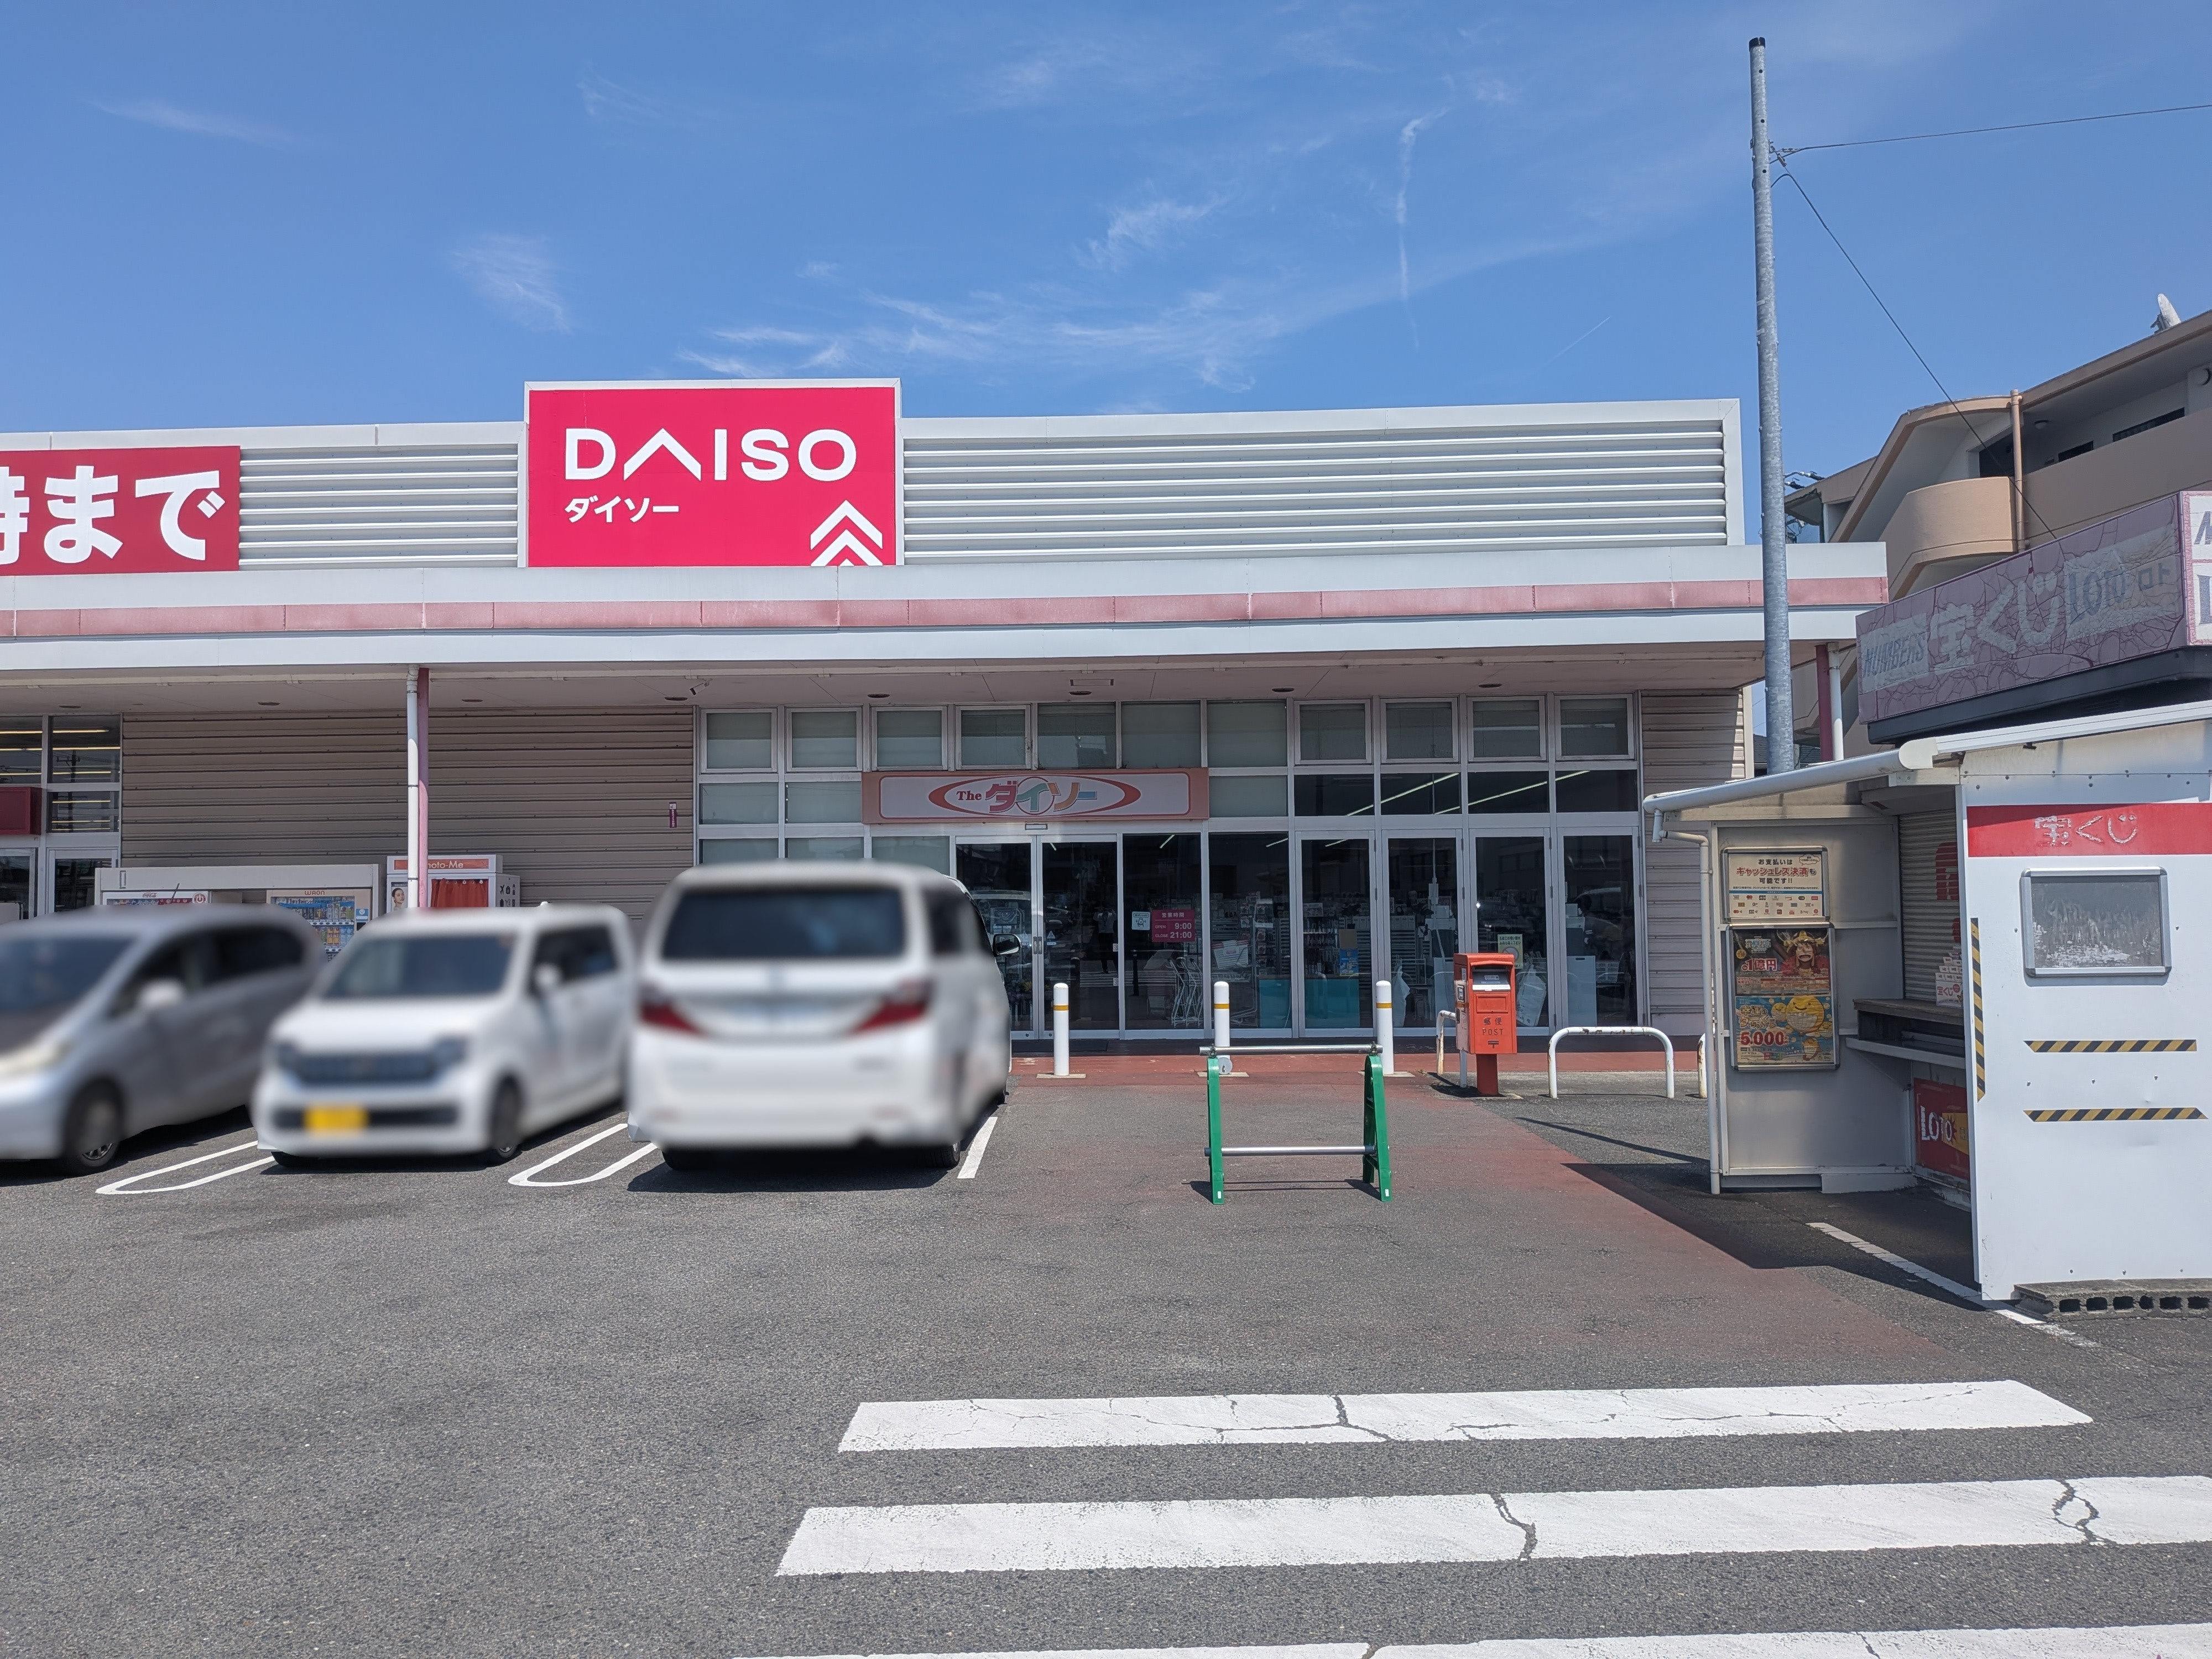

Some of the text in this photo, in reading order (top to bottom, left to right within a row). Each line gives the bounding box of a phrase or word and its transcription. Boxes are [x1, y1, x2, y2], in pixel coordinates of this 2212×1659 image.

[565, 428, 857, 482] DAISO
[565, 495, 679, 523] ダイソー
[956, 780, 1098, 813] The ダイソー
[1746, 958, 1777, 971] 1億円
[1740, 1005, 1767, 1016] 幸運の
[1483, 1017, 1502, 1026] 郵便
